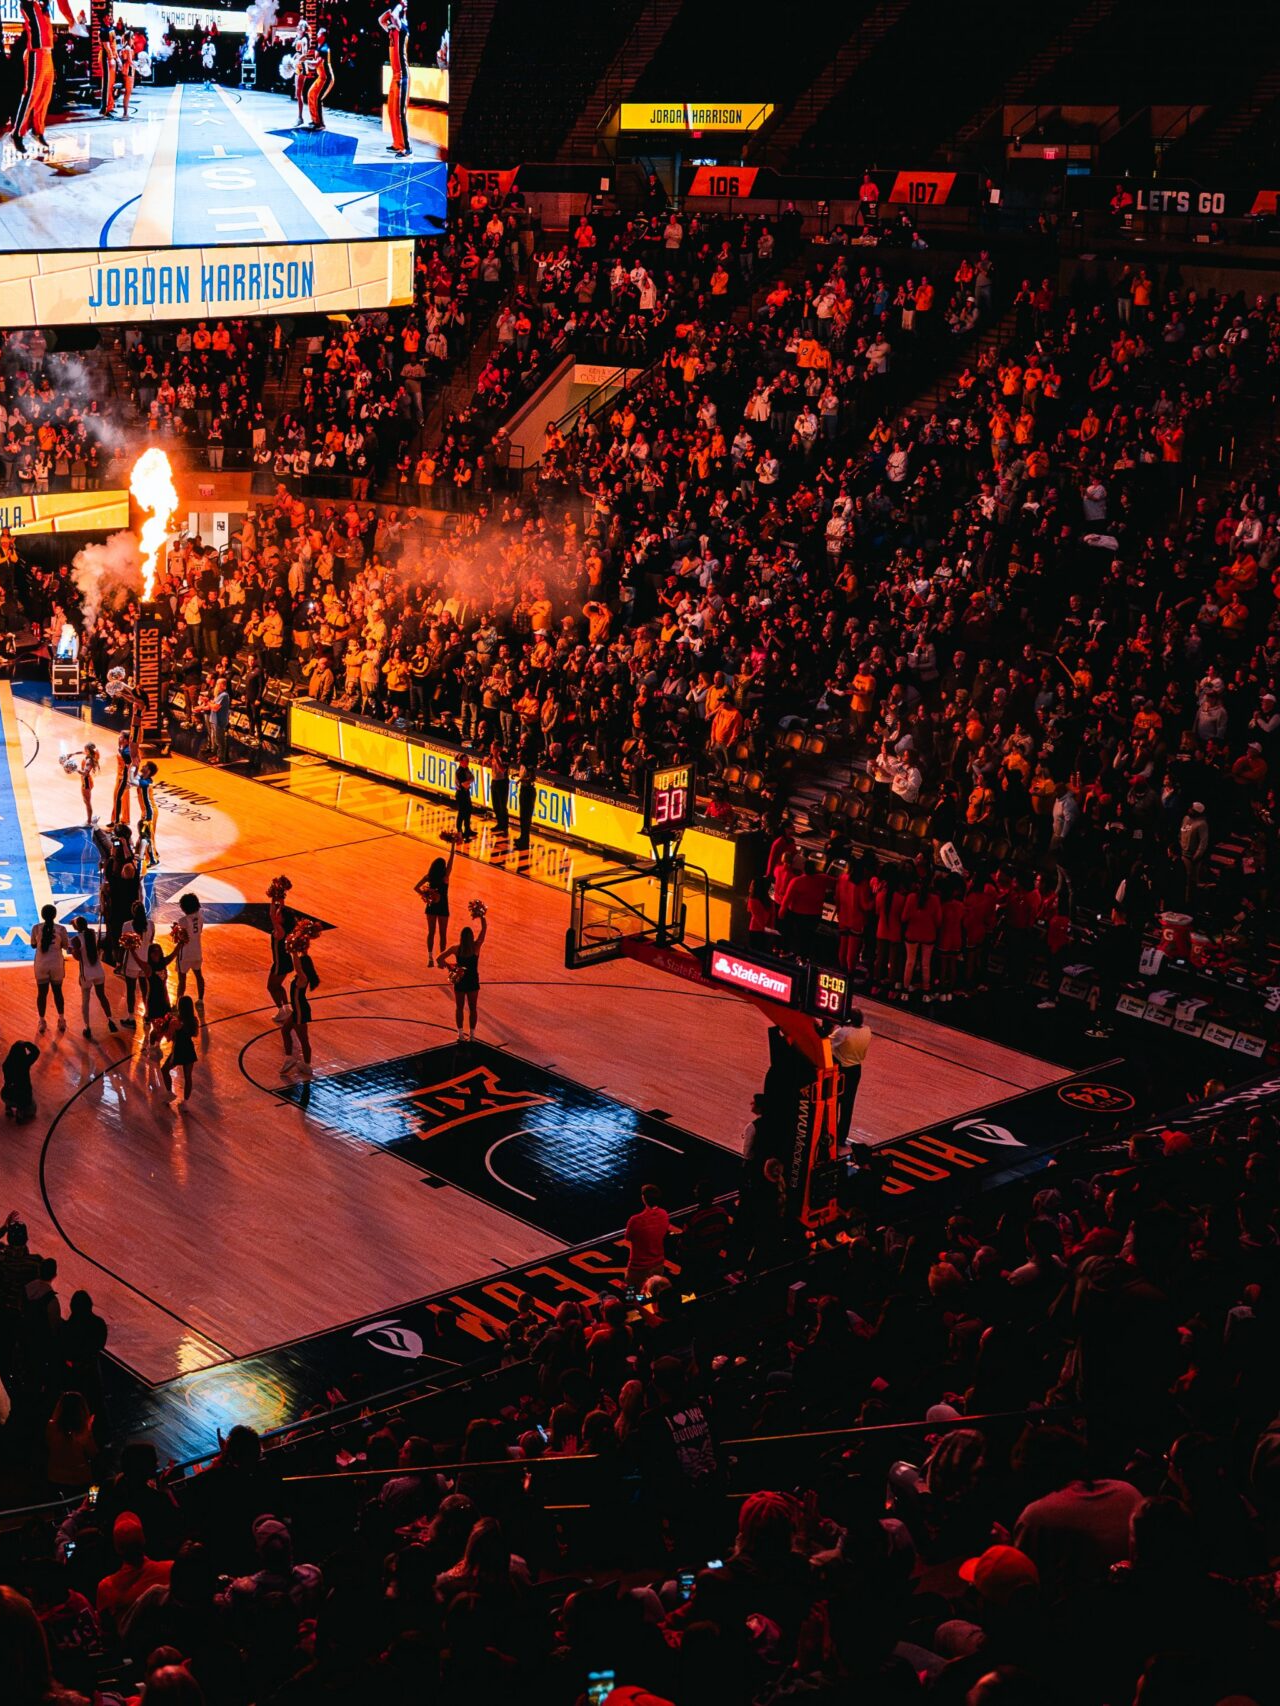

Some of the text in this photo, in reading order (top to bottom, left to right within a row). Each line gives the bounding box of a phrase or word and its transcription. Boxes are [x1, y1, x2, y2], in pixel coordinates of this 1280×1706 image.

[650, 109, 742, 124] JORDAN HARRISON
[709, 176, 739, 196] 106
[908, 181, 938, 203] 107
[1137, 189, 1225, 214] LET'S GO
[89, 260, 313, 308] JORDAN HARRISON
[658, 770, 688, 791] 10:00
[656, 789, 684, 823] 30
[1163, 927, 1175, 942] G
[820, 973, 845, 993] 10:00
[819, 989, 840, 1012] 30
